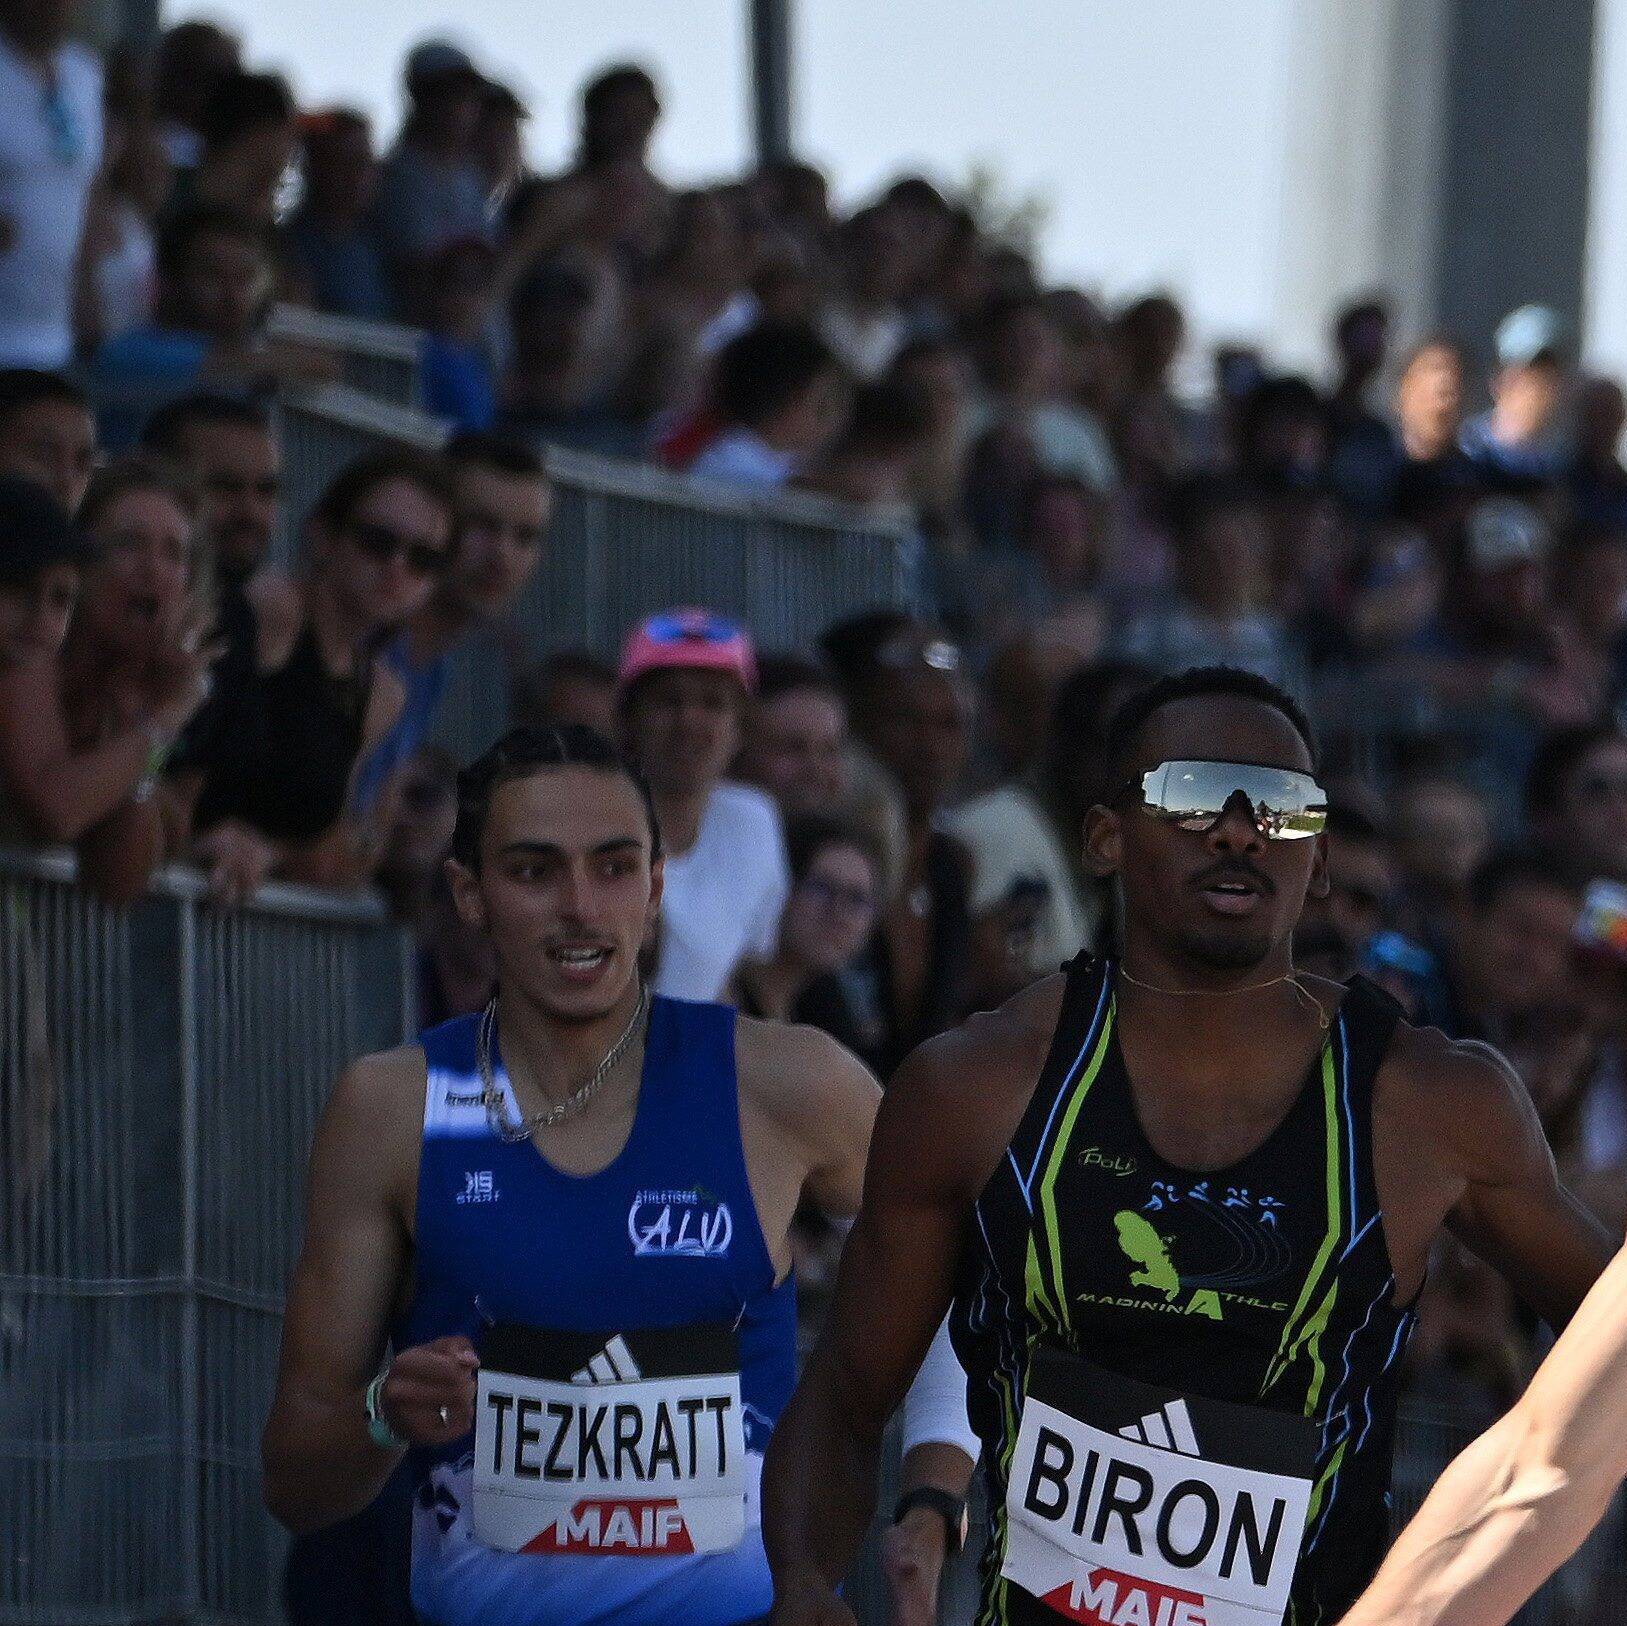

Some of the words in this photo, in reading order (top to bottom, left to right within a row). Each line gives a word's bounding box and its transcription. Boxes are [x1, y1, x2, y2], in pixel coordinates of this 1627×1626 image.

[487, 1392, 732, 1482] TEZKRATT
[554, 1505, 685, 1548] MAIF
[1023, 1424, 1287, 1588] BIRON
